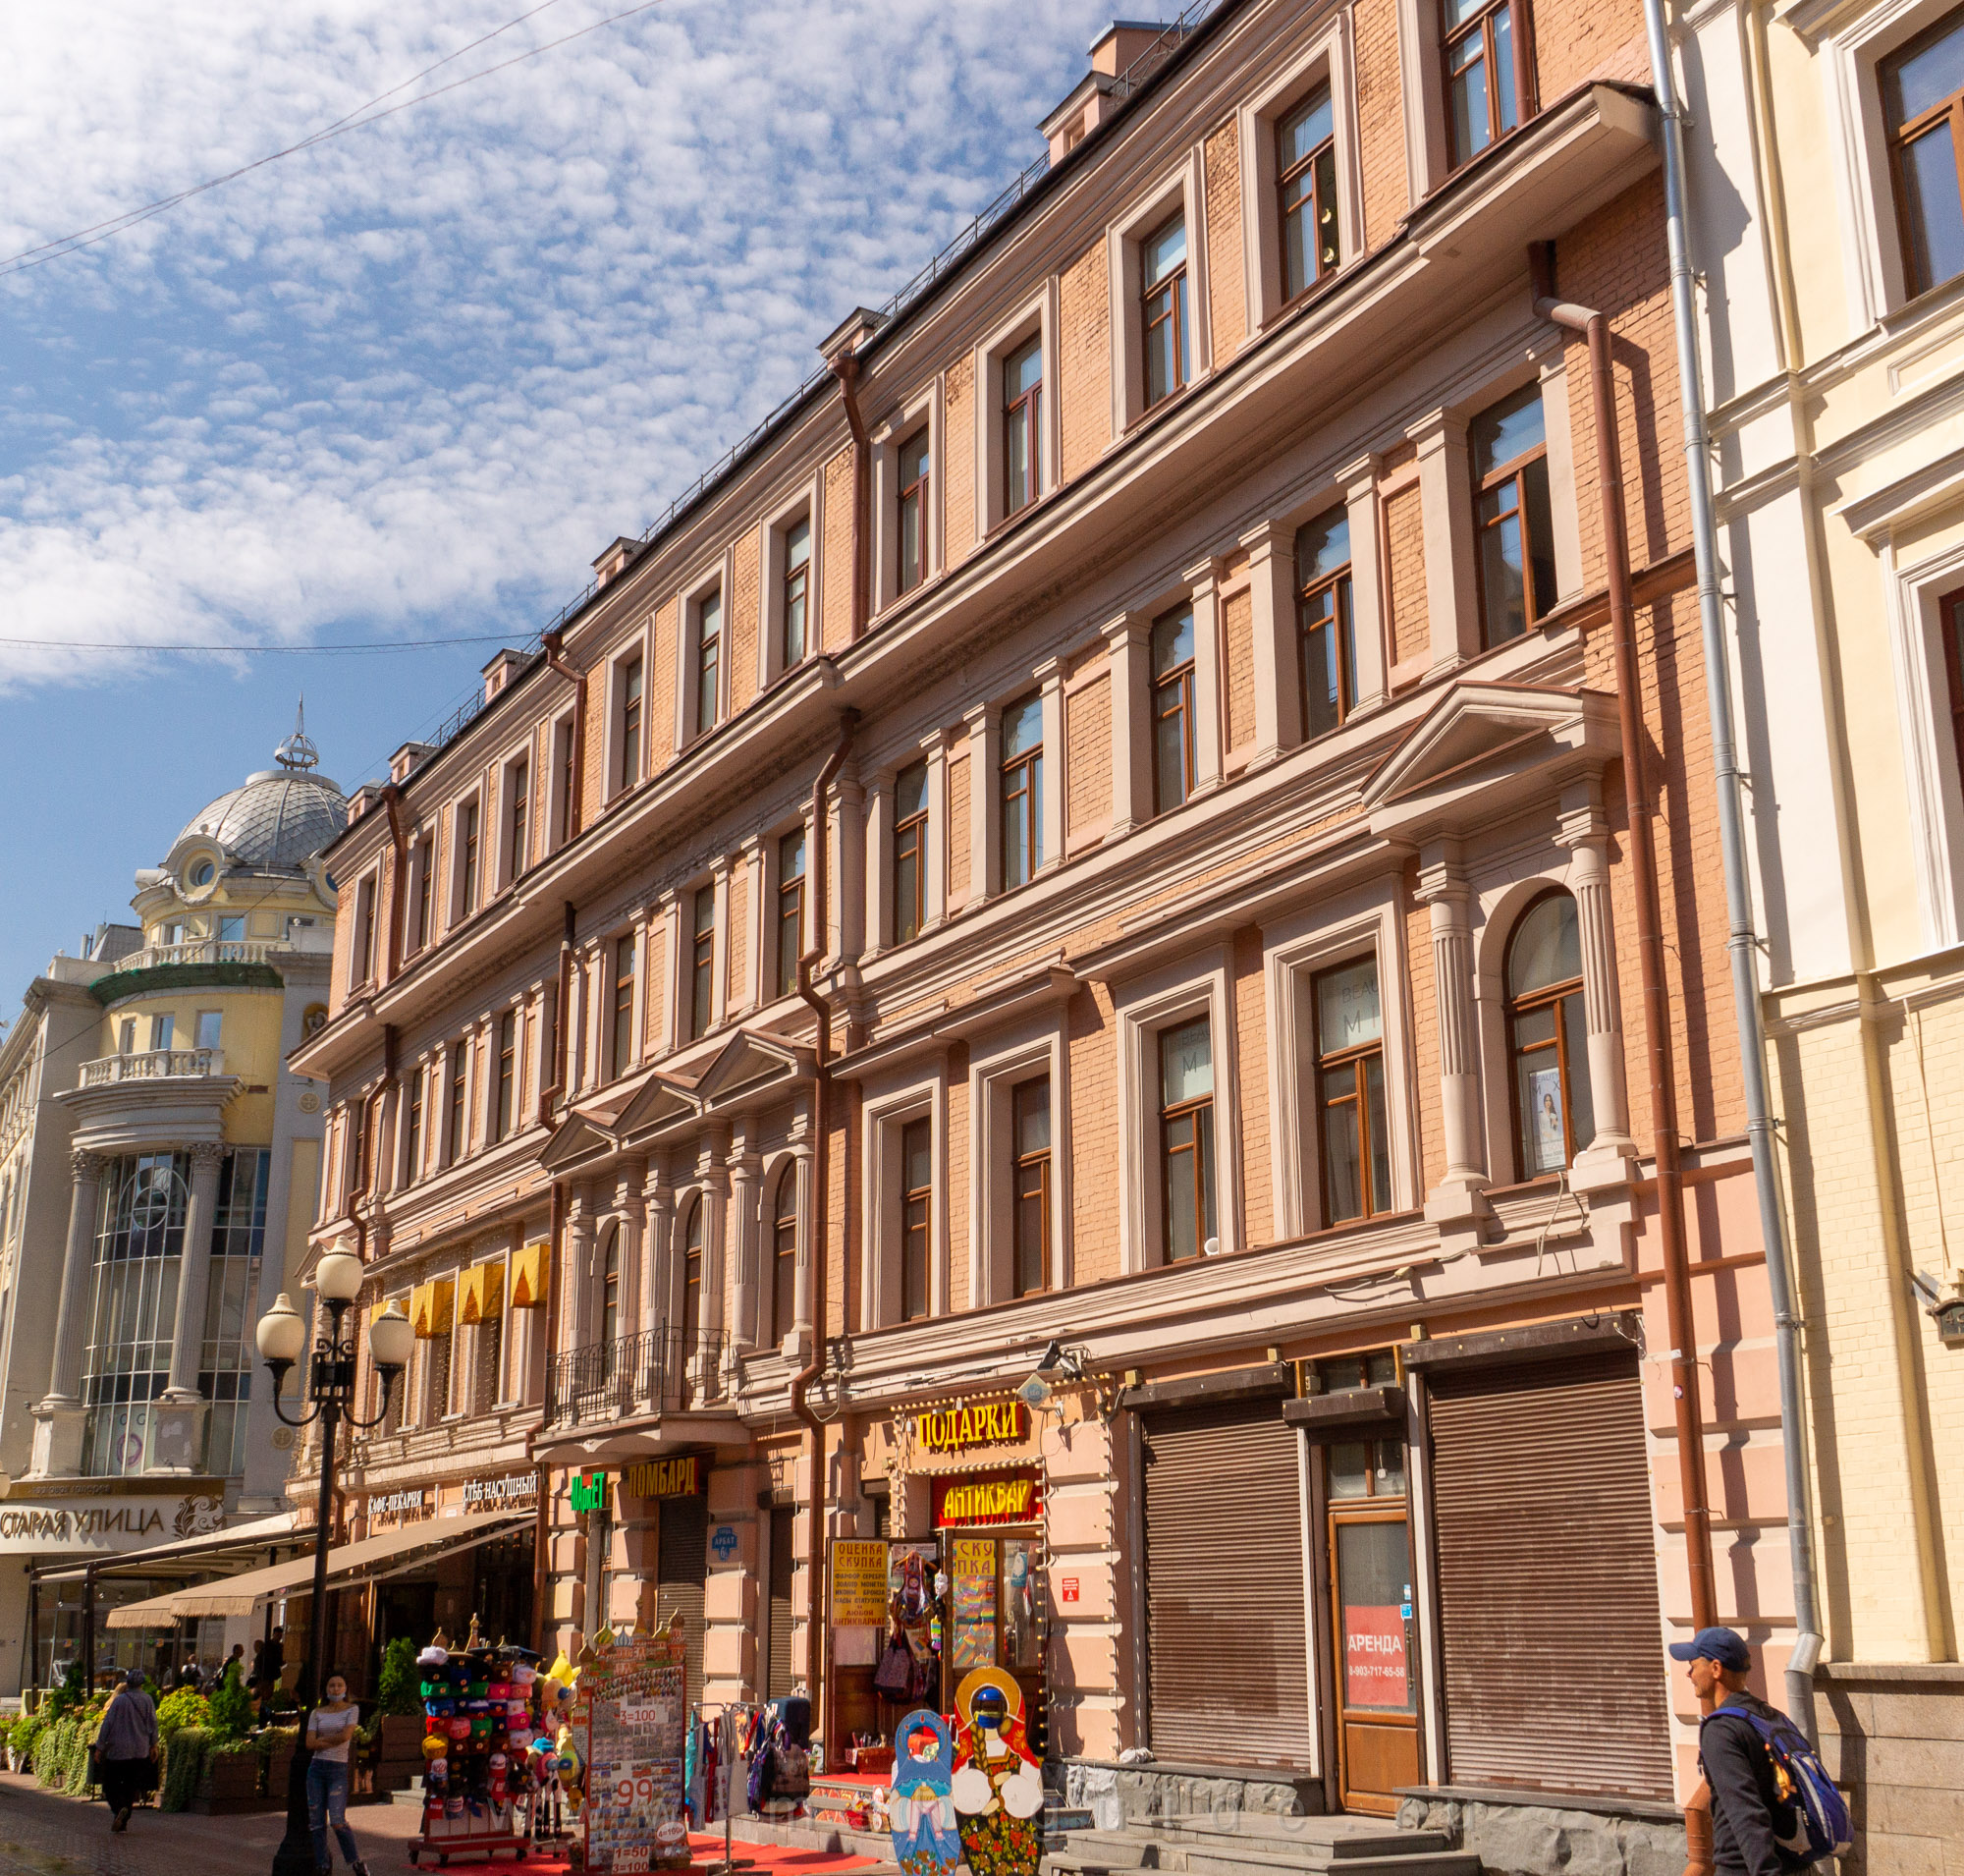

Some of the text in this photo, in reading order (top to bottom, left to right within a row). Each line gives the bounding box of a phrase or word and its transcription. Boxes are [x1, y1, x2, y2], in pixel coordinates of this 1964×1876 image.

[918, 1402, 1018, 1452] ПОДАРКИ
[628, 1457, 696, 1498] ЛОМБАРД
[485, 1470, 537, 1500] НАСУЩНЫЙ
[944, 1479, 1030, 1518] АНТИКВАР
[0, 1509, 164, 1539] СТАРАЯ УЛИЦА
[839, 1543, 883, 1555] ОЦЕНКА
[960, 1542, 993, 1556] СКУ
[839, 1557, 882, 1568] СКУПКА
[957, 1560, 991, 1573] ПКА
[1347, 1634, 1403, 1656] АРЕНДА
[1348, 1665, 1405, 1678] 8-903-717-65-58
[620, 1709, 656, 1722] 3=100
[617, 1779, 653, 1807] 99
[616, 1846, 649, 1858] 1=50
[612, 1860, 649, 1873] 3=100
